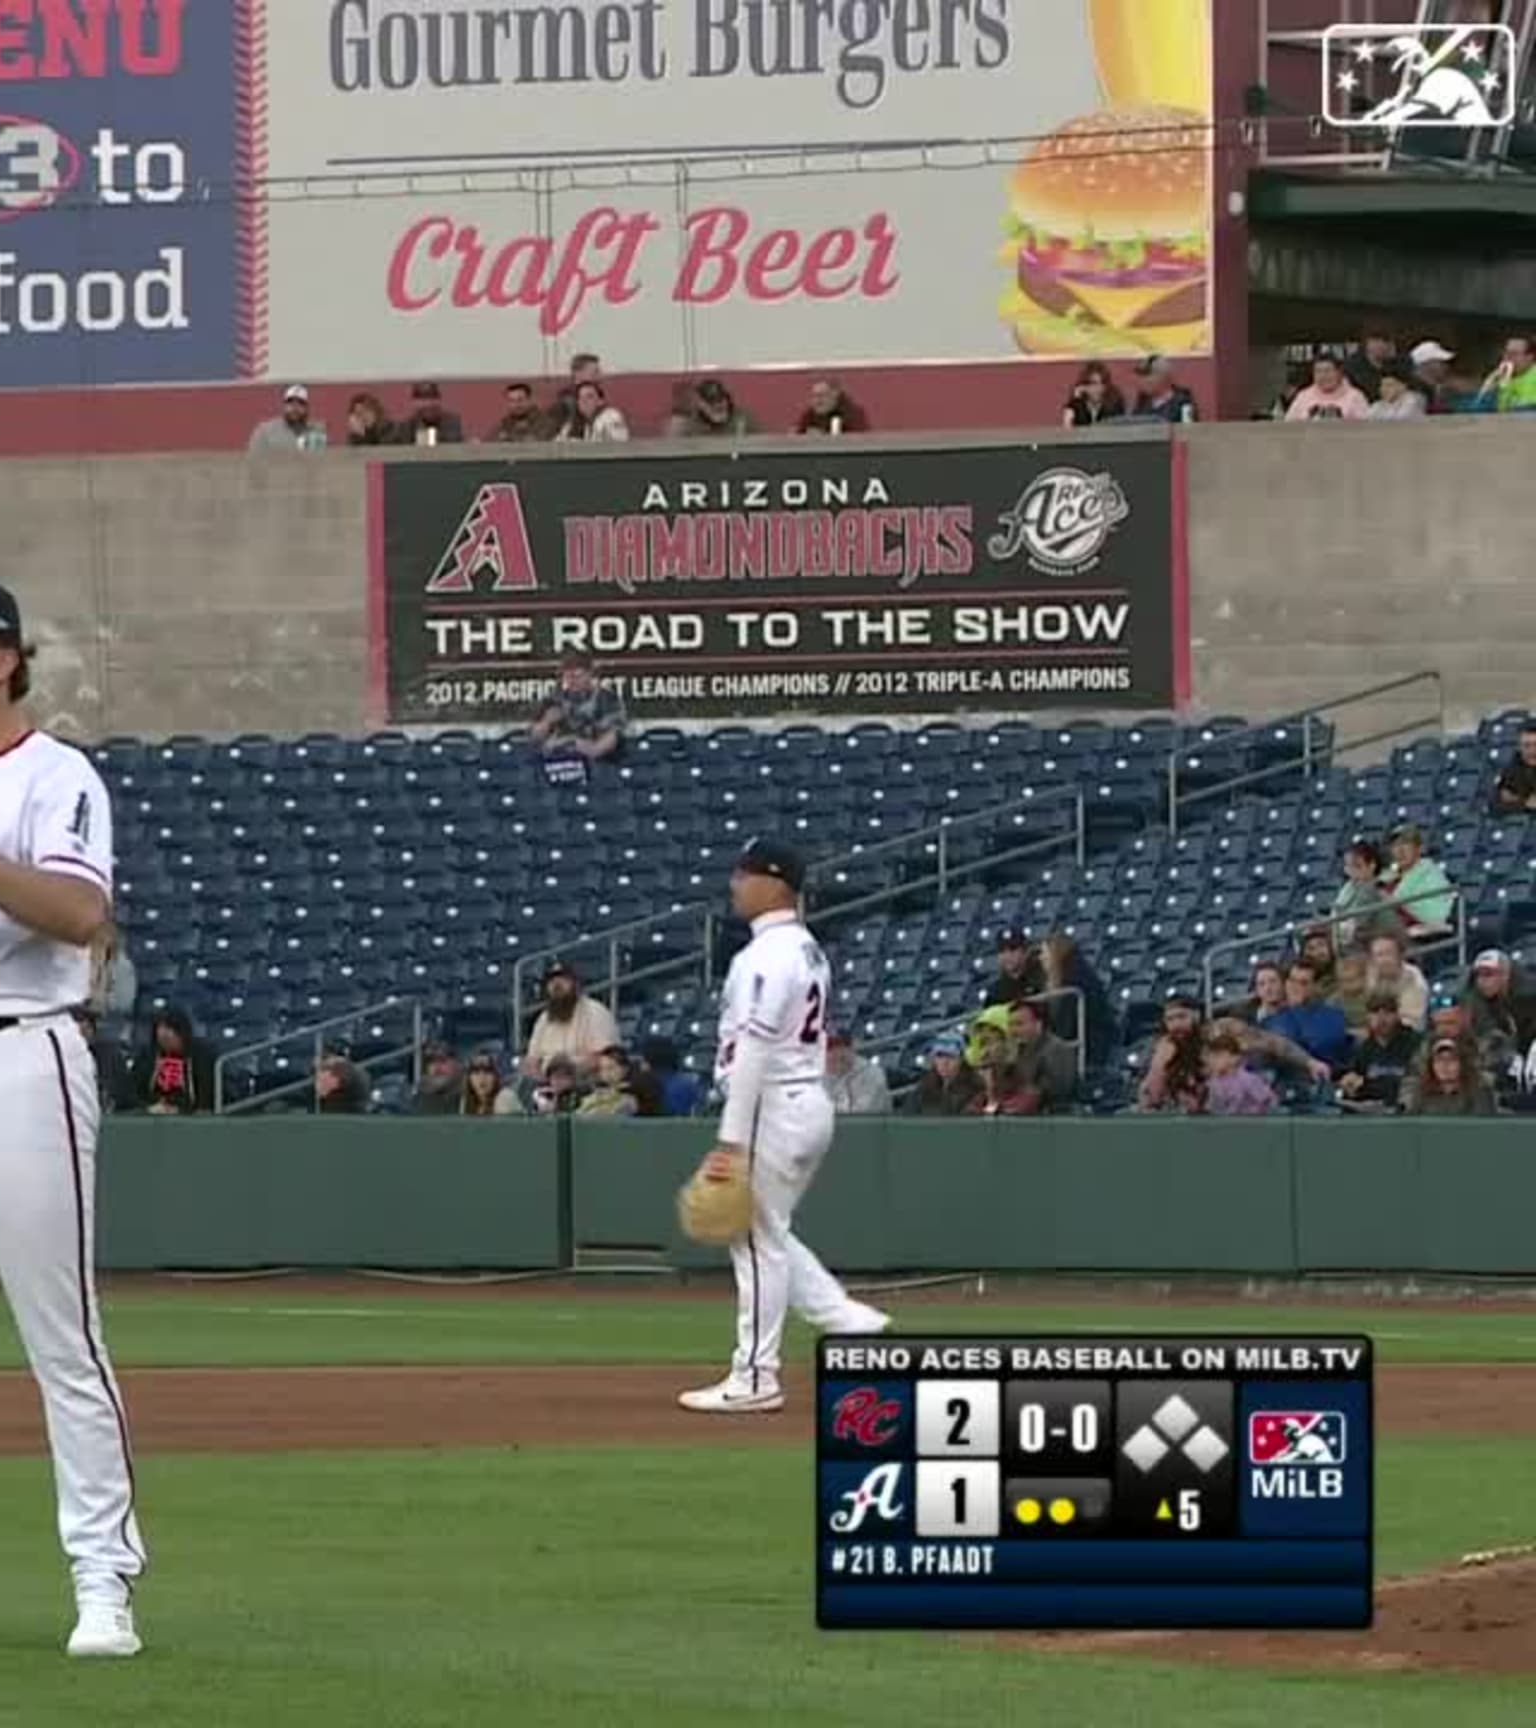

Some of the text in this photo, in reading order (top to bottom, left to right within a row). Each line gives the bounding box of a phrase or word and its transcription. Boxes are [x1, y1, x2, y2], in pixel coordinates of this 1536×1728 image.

[329, 0, 1010, 109] Gourmet Burgers
[91, 128, 185, 205] to
[385, 205, 902, 336] Craft Beer
[642, 477, 890, 509] ARIZONA
[565, 505, 973, 593] DIAMONDBACKS
[426, 602, 1131, 654] THE ROAD TO THE SHOW
[426, 682, 479, 704] 2012
[632, 675, 704, 698] LEAGUE
[711, 672, 829, 697] CHAMPIONS
[855, 671, 908, 694] 2012
[914, 670, 1004, 692] TRIPLE-A
[1009, 667, 1130, 690] CHAMPIONS
